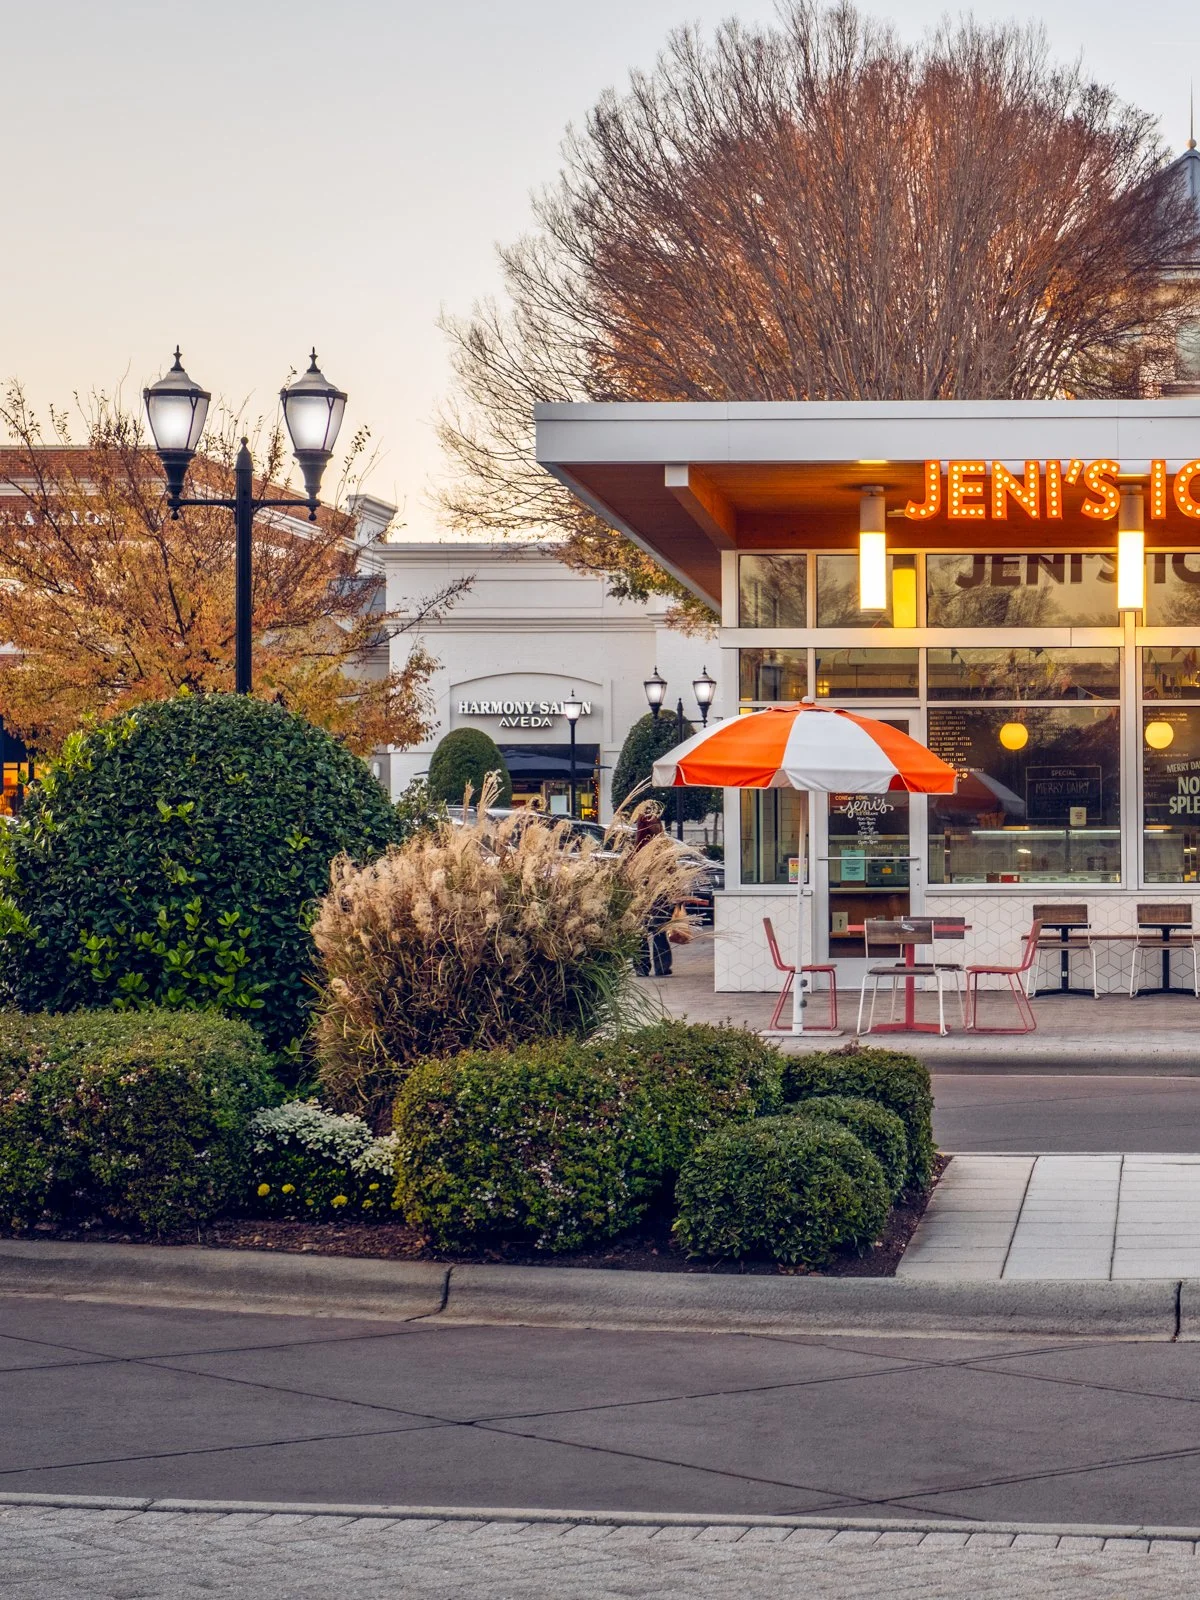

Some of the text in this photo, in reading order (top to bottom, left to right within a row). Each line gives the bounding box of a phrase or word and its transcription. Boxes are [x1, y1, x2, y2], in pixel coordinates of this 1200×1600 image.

[904, 459, 1121, 520] JENI'S
[458, 701, 591, 714] HARMONY SALN
[498, 716, 552, 727] AVEDA
[1051, 769, 1077, 777] SPECIAL
[1166, 761, 1190, 774] MERRY
[840, 796, 894, 818] jeni's
